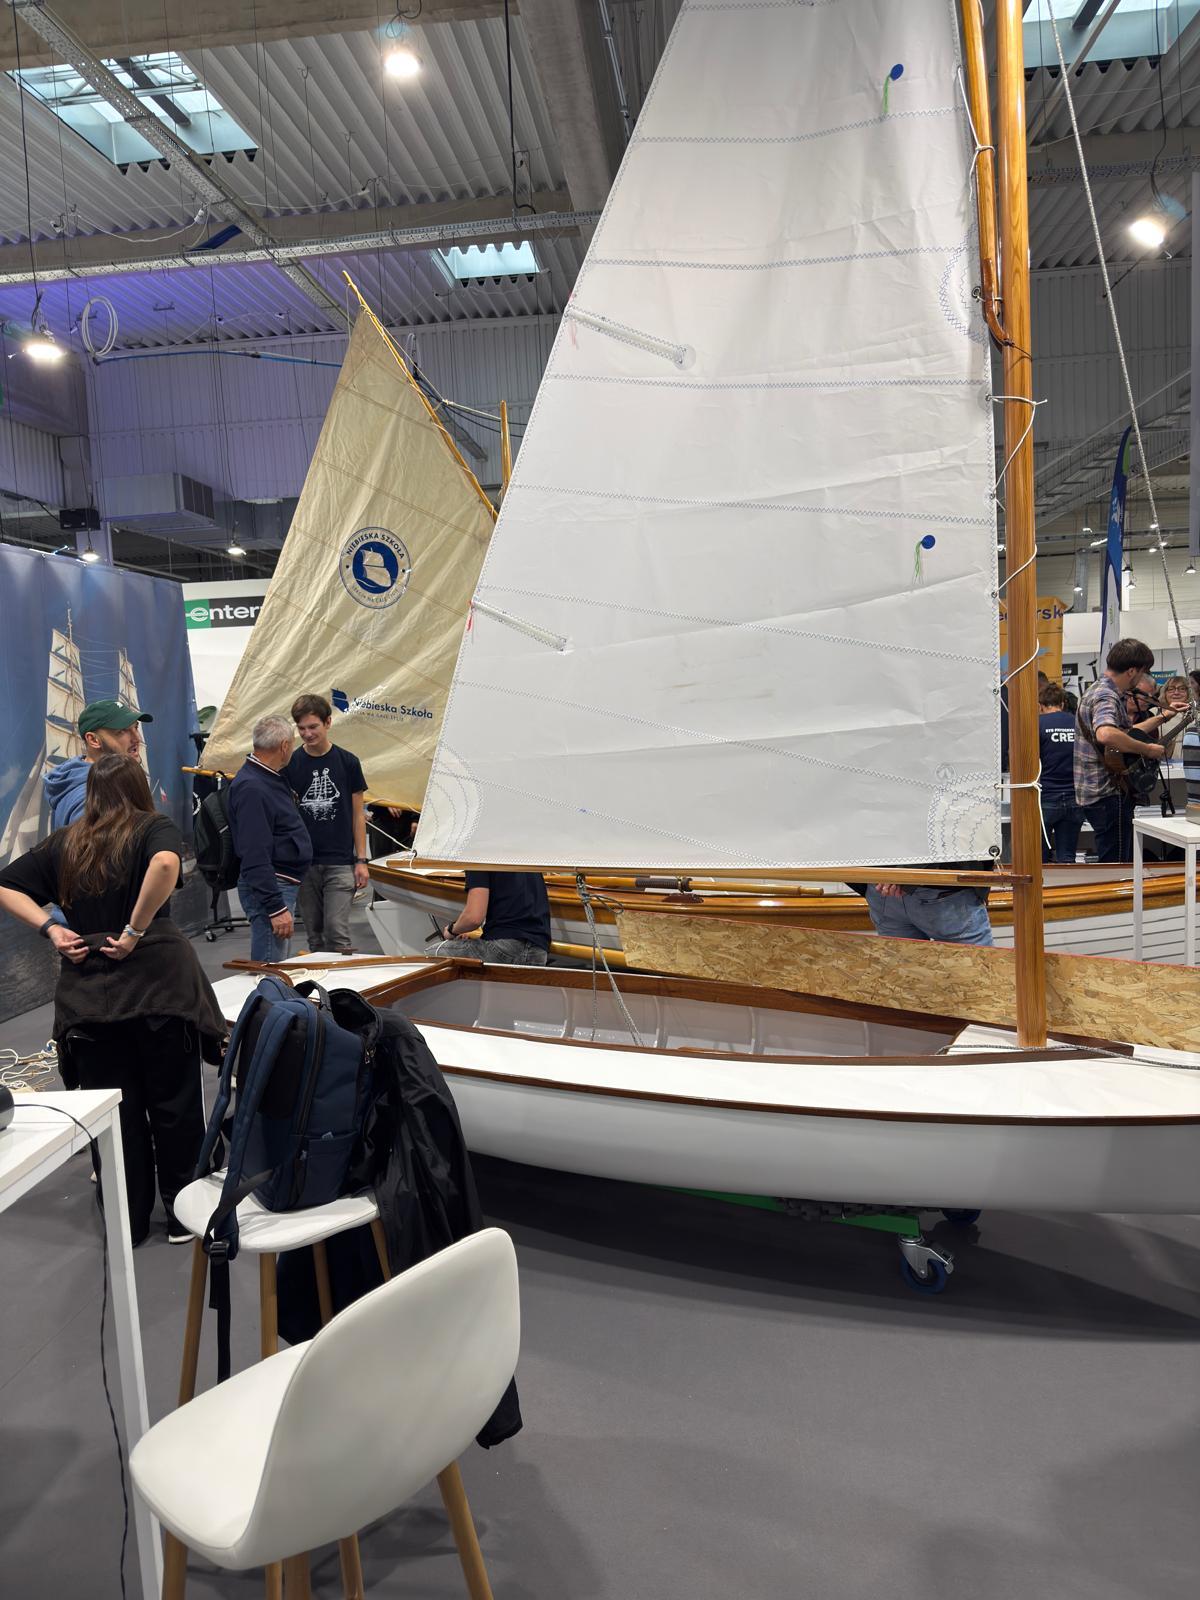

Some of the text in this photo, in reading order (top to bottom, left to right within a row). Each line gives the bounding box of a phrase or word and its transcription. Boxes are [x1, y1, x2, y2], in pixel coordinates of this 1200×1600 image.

[346, 533, 405, 559] NIEBIESKA SZKOŁA
[188, 605, 262, 622] enter
[400, 705, 433, 719] Szkoła
[1050, 732, 1076, 743] CRE
